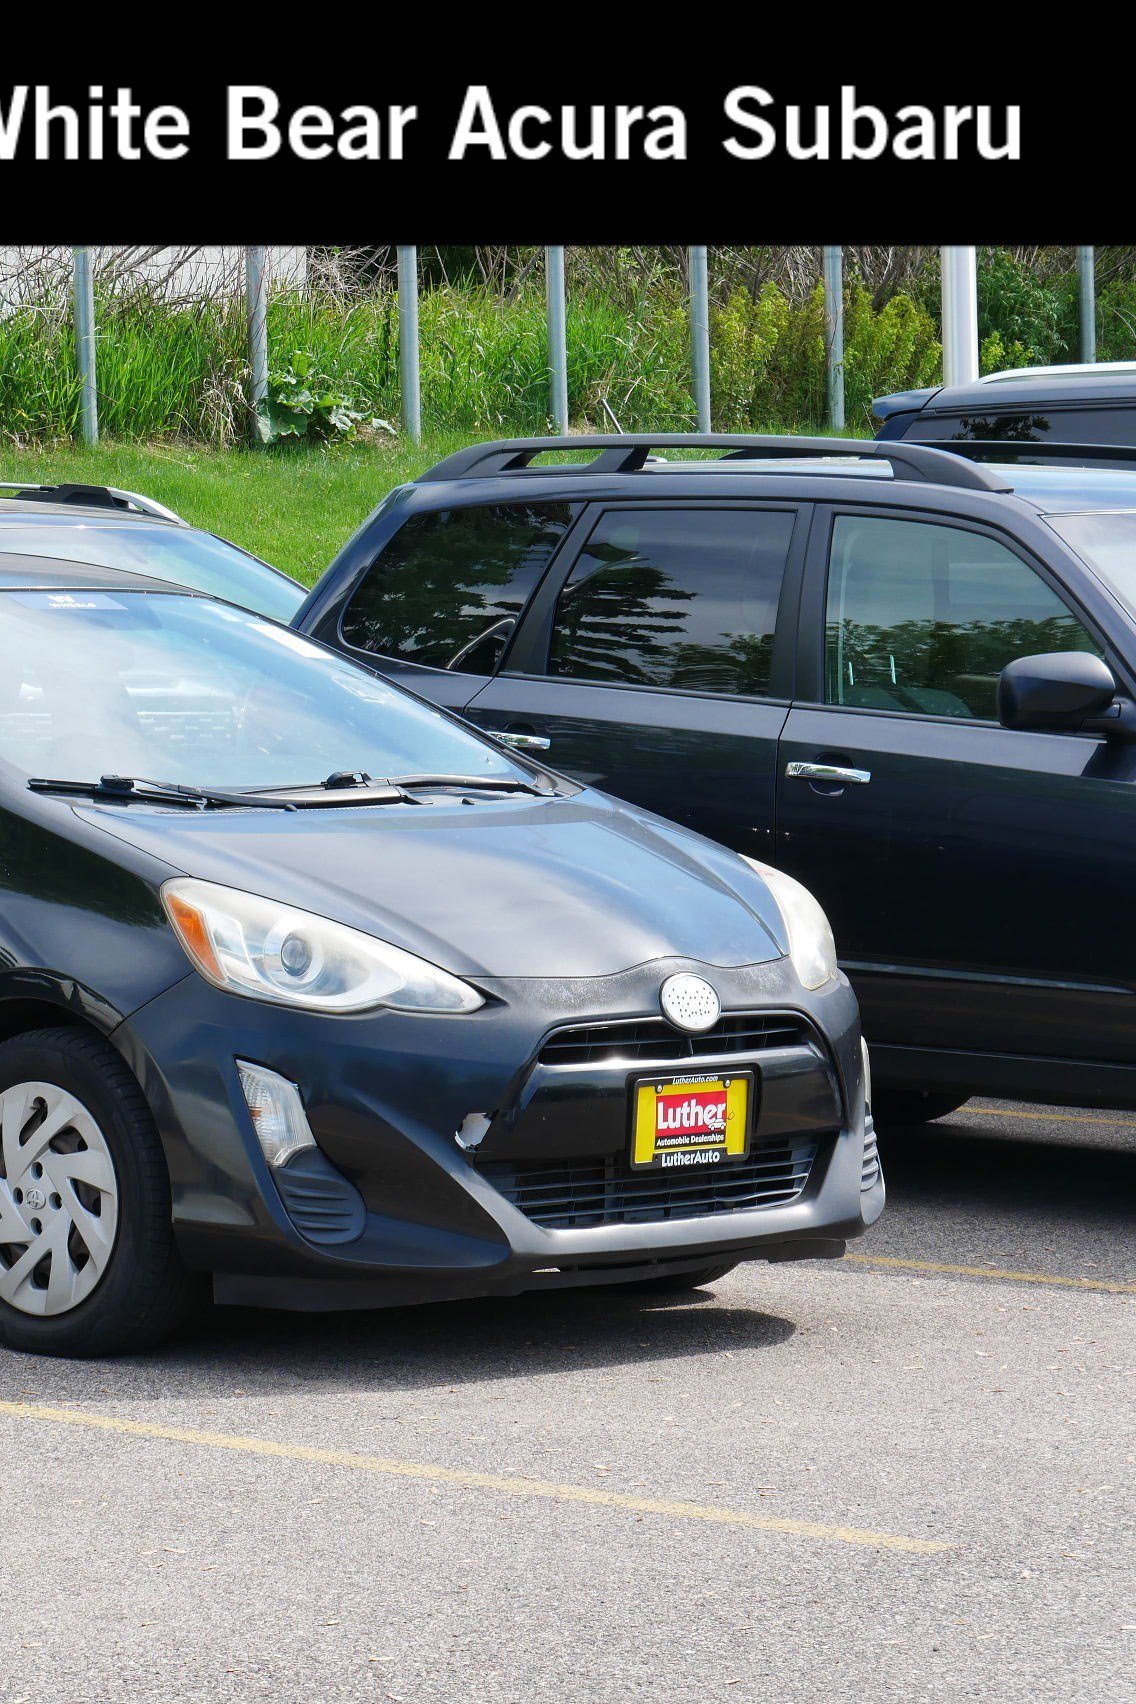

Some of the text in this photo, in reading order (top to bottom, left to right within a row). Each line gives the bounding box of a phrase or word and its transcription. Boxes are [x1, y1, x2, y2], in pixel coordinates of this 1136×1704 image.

[671, 1075, 719, 1086] LutherAuto.com
[657, 1098, 727, 1130] Luther
[656, 1132, 725, 1147] Automobile Dealerships
[661, 1149, 721, 1168] LutherAuto
